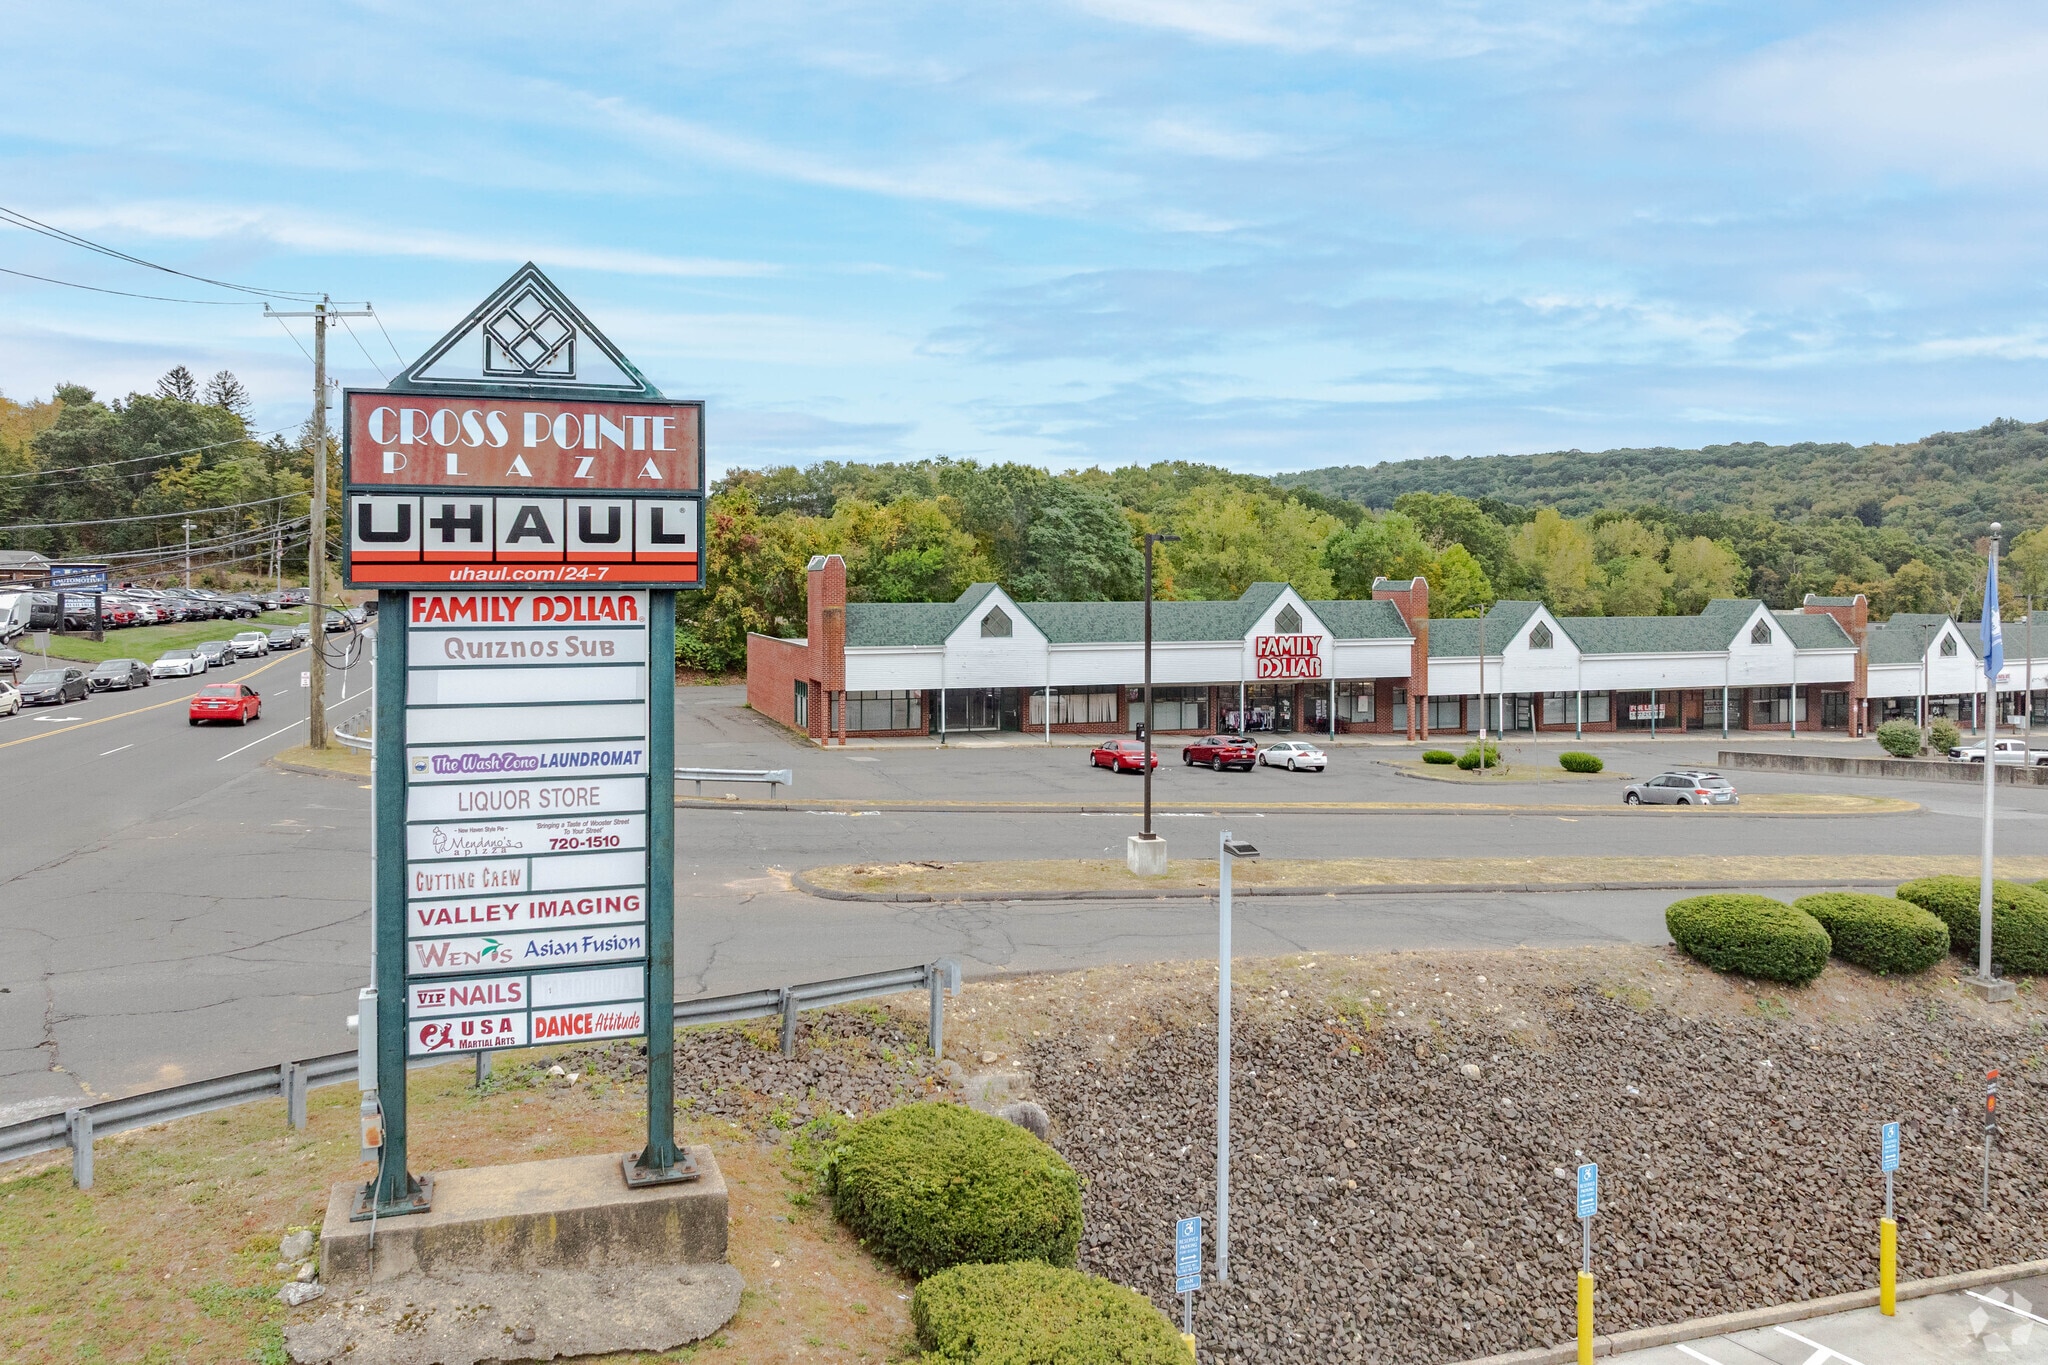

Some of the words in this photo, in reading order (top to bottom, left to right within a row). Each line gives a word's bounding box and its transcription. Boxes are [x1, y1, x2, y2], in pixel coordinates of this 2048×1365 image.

[368, 406, 509, 448] CROSS
[523, 411, 677, 451] POINTE
[382, 451, 663, 480] PLAZA
[449, 566, 610, 582] uhaul.com/24-7
[412, 596, 524, 623] FAMILY
[532, 595, 638, 622] DOLLAR
[1256, 636, 1322, 657] FAMILY
[1257, 657, 1322, 678] DOLLAR
[434, 757, 459, 773] The
[462, 756, 501, 771] Wash
[502, 754, 537, 770] Zone
[540, 750, 642, 769] LAUNDROMAT
[458, 790, 530, 811] LIQUOR
[539, 787, 600, 808] STORE
[567, 820, 581, 828] Taste
[590, 819, 612, 827] Wooster
[613, 818, 630, 826] Street
[549, 835, 620, 850] 720-1510
[416, 870, 475, 892] CUTTING
[483, 866, 521, 888] CREW
[417, 902, 520, 926] VALLEY
[529, 895, 640, 919] IMAGING
[523, 939, 578, 958] Asian
[582, 934, 640, 954] Fusion
[417, 993, 445, 1004] VIP
[450, 982, 522, 1007] NAILS
[461, 1017, 512, 1036] USA
[535, 1012, 593, 1039] DANCE
[595, 1010, 641, 1032] Attitude
[459, 1039, 493, 1049] MARTIAL
[494, 1036, 515, 1046] ARTS
